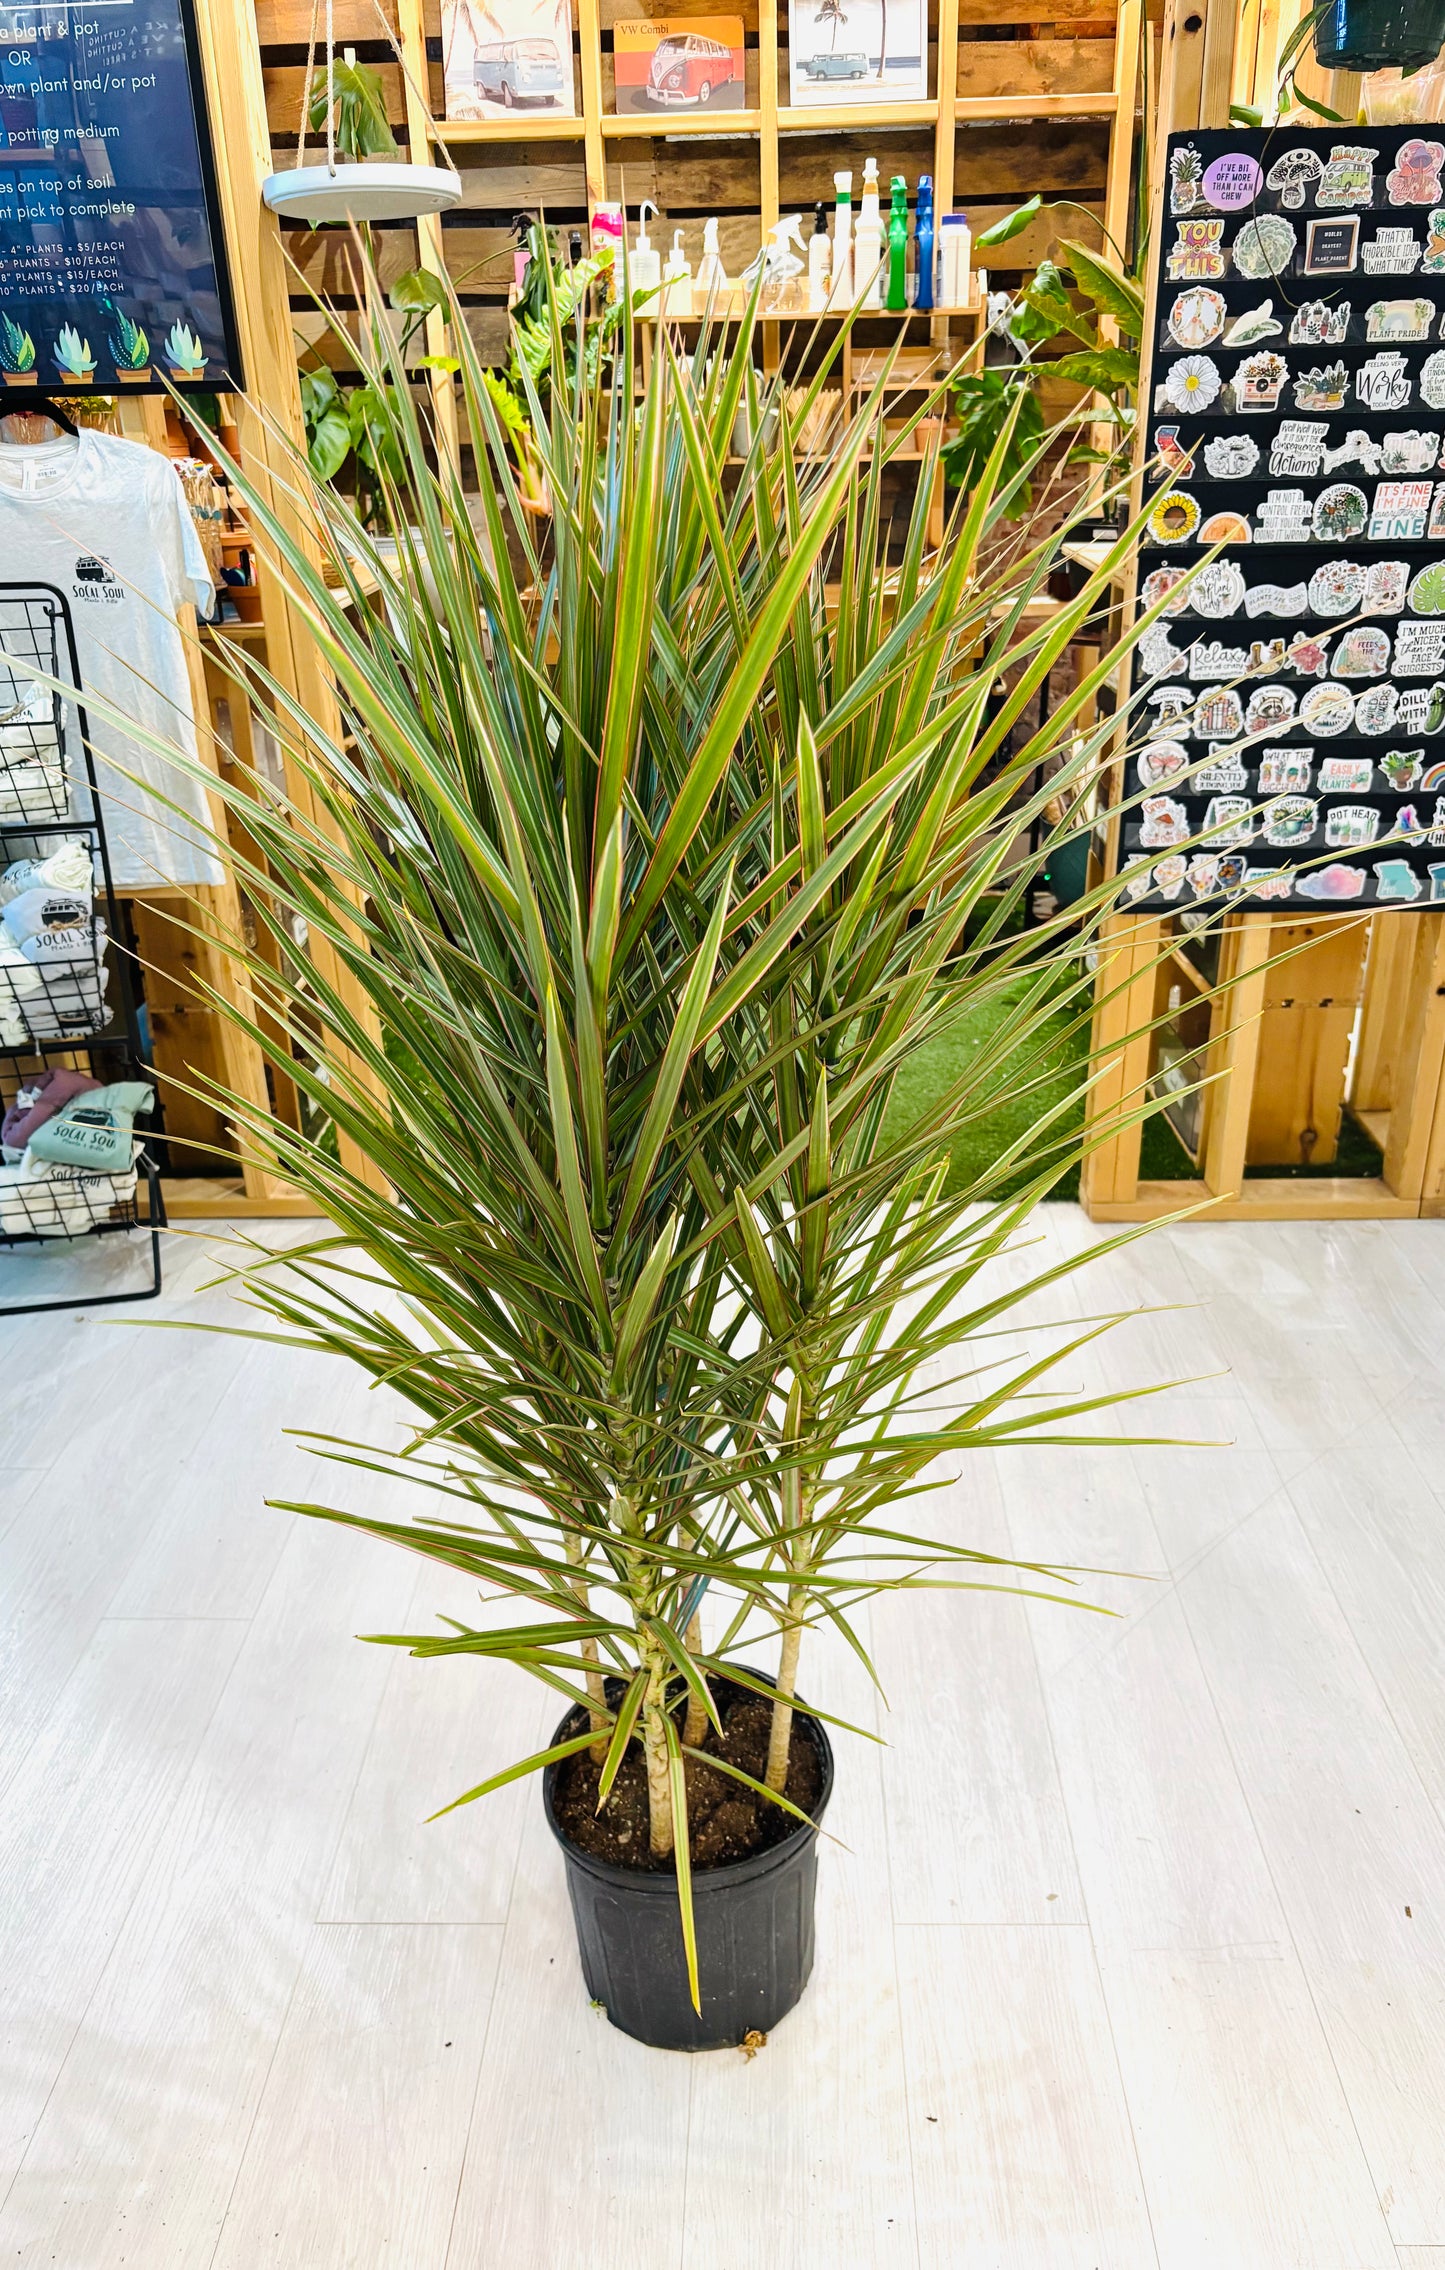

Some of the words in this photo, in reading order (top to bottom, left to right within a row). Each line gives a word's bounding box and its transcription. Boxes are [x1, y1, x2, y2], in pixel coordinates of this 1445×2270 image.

[14, 24, 52, 43] plant
[57, 20, 69, 36] &
[74, 20, 99, 39] pot
[620, 26, 638, 35] VW
[640, 23, 669, 34] Combi
[8, 50, 31, 66] OR
[0, 84, 26, 96] own
[30, 76, 69, 98] plant
[73, 73, 126, 93] and/or
[131, 73, 157, 93] pot
[8, 128, 59, 146] potting
[64, 122, 120, 140] medium
[1220, 164, 1236, 172] I'VE
[1238, 164, 1250, 172] BIT
[1216, 173, 1229, 181] OFF
[1232, 173, 1252, 181] MORE
[18, 181, 35, 192] on
[39, 177, 63, 195] top
[68, 176, 82, 190] of
[87, 173, 111, 189] soil
[1212, 182, 1231, 191] THAN
[1238, 183, 1254, 191] CAN
[1221, 192, 1242, 200] CHEW
[17, 202, 46, 222] pick
[50, 203, 64, 216] to
[69, 199, 136, 219] complete
[1180, 222, 1221, 241] YOU
[1381, 230, 1405, 241] THAT'S
[1407, 229, 1412, 240] A
[26, 244, 64, 254] PLANTS
[77, 242, 125, 254] $5/EACH
[1366, 245, 1401, 259] HORRIBLE
[13, 258, 50, 268] PLANTS
[64, 256, 116, 267] $10/EACH
[1169, 257, 1221, 276] THIS
[1368, 260, 1391, 273] WHAT
[1393, 258, 1415, 272] TIME?
[16, 272, 53, 281] PLANTS
[67, 269, 119, 280] $15/EACH
[19, 285, 56, 295] PLANTS
[69, 283, 124, 294] $20/EACH
[1369, 329, 1396, 338] PLANT
[1378, 485, 1401, 497] IT'S
[1402, 483, 1431, 496] FINE
[1270, 492, 1282, 502] I'M
[1283, 492, 1296, 502] NOT
[1376, 497, 1395, 509] I'M
[1397, 496, 1428, 508] FINE
[1259, 504, 1289, 516] CONTROL
[1291, 504, 1311, 515] FREAK
[1265, 518, 1279, 528] BUT
[1280, 517, 1301, 528] YOU'RE
[1370, 518, 1424, 537] FINE
[1256, 530, 1274, 542] DOING
[1275, 530, 1283, 541] IT
[1284, 529, 1309, 541] WRONG
[103, 585, 126, 599] SOUL
[1402, 627, 1416, 637] I'M
[1419, 625, 1445, 635] MUCH
[1414, 636, 1440, 646] NICER
[1400, 640, 1425, 656] than
[1427, 644, 1443, 658] my
[1411, 653, 1432, 663] FACE
[1397, 662, 1442, 674] SUGGESTS
[1367, 698, 1379, 719] WILD
[1399, 708, 1427, 721] WITH
[1409, 723, 1419, 733] IT
[1264, 751, 1290, 760] WHAT
[1295, 751, 1311, 761] THE
[1331, 764, 1361, 775] EASILY
[1200, 772, 1243, 781] SILENTLY
[1229, 782, 1244, 790] YOU
[1320, 780, 1351, 789] PLANTS
[1330, 809, 1349, 823] POT
[1351, 808, 1377, 822] HEAD
[36, 931, 75, 948] SOCAL
